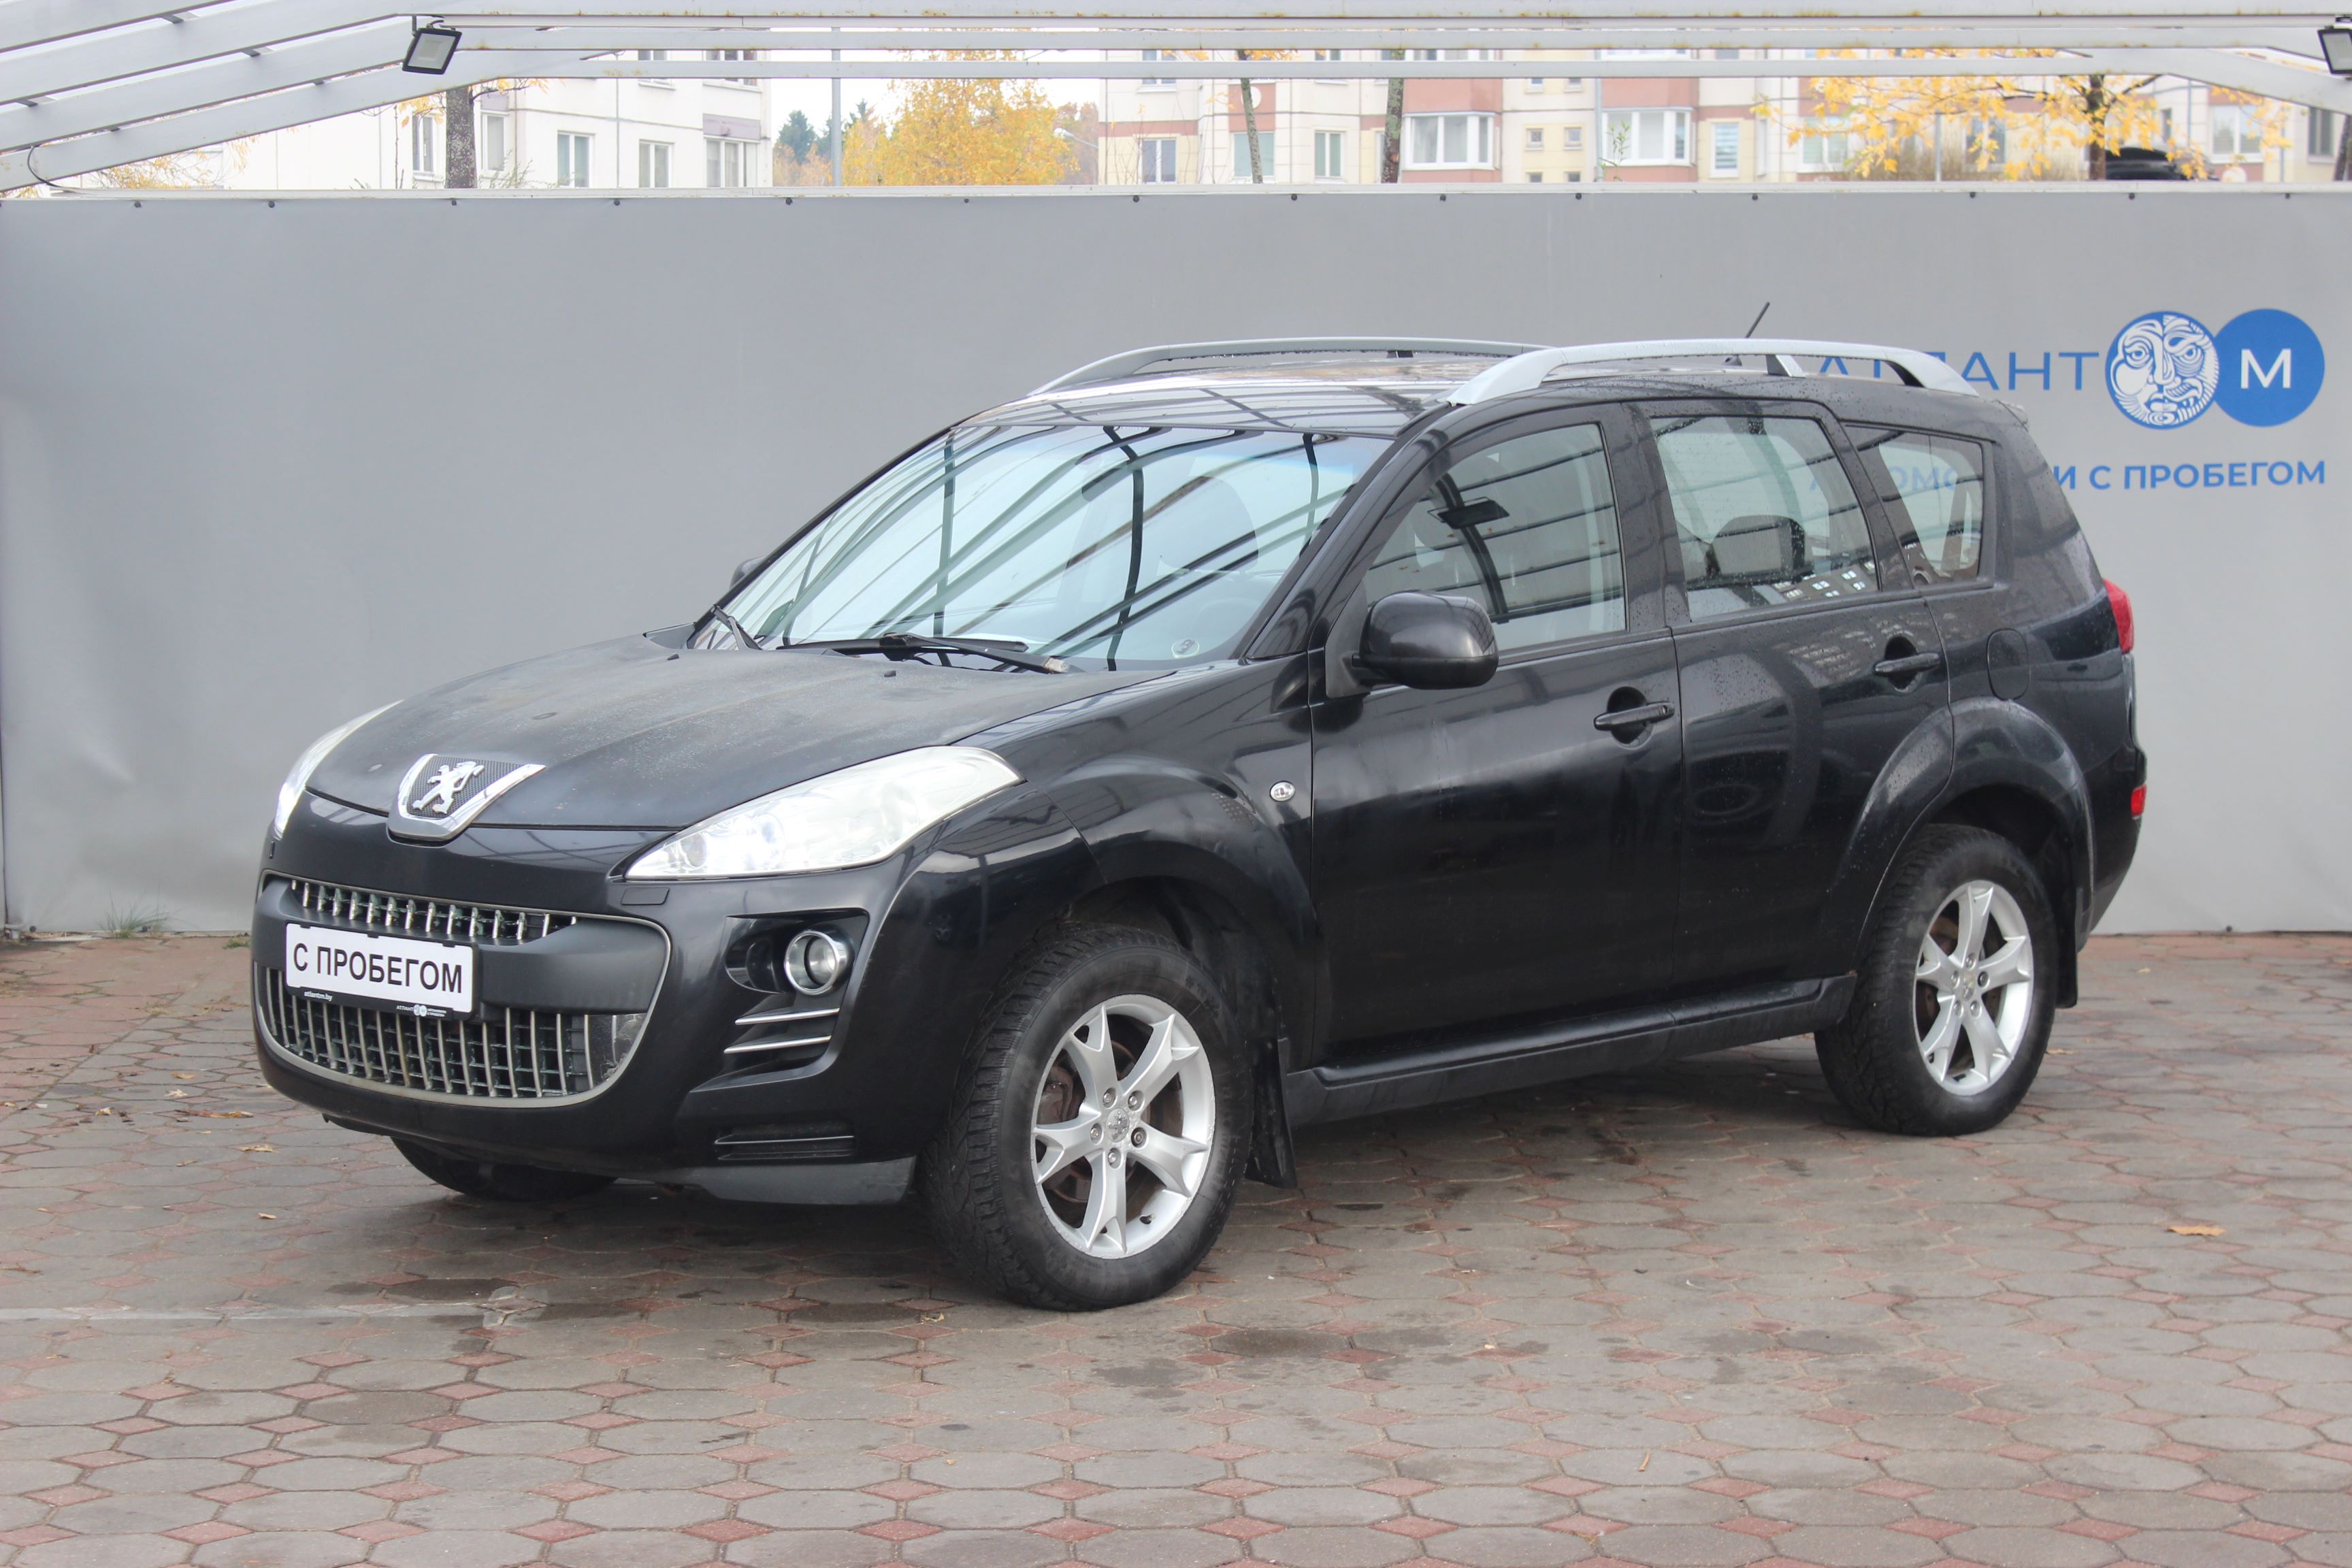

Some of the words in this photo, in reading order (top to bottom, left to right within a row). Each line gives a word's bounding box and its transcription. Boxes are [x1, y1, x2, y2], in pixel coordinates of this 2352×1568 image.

[2240, 348, 2291, 389] М
[2089, 466, 2112, 490] С
[2124, 461, 2325, 489] ПРОБЕГОМ
[293, 943, 308, 971] С
[317, 946, 461, 993] ПРОБЕГОМ
